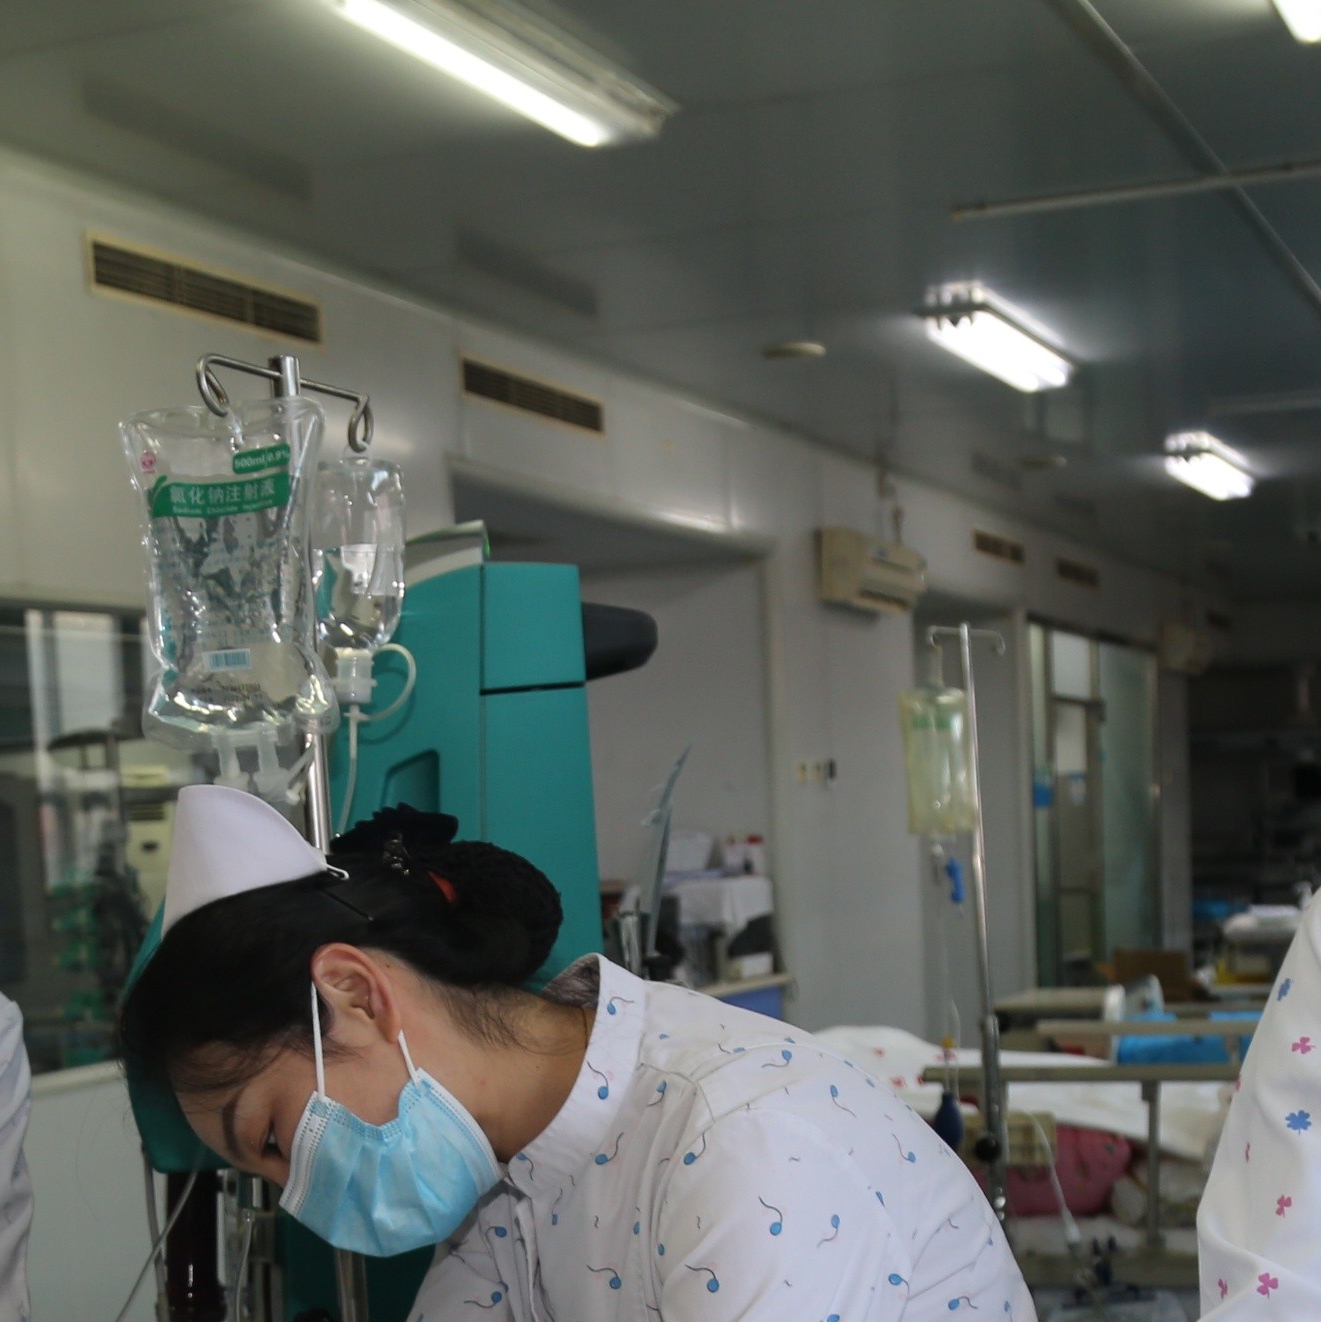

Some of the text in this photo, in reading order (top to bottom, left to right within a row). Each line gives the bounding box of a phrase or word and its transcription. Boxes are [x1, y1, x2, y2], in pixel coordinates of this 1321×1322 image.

[169, 478, 276, 505] 氯化钠注射液
